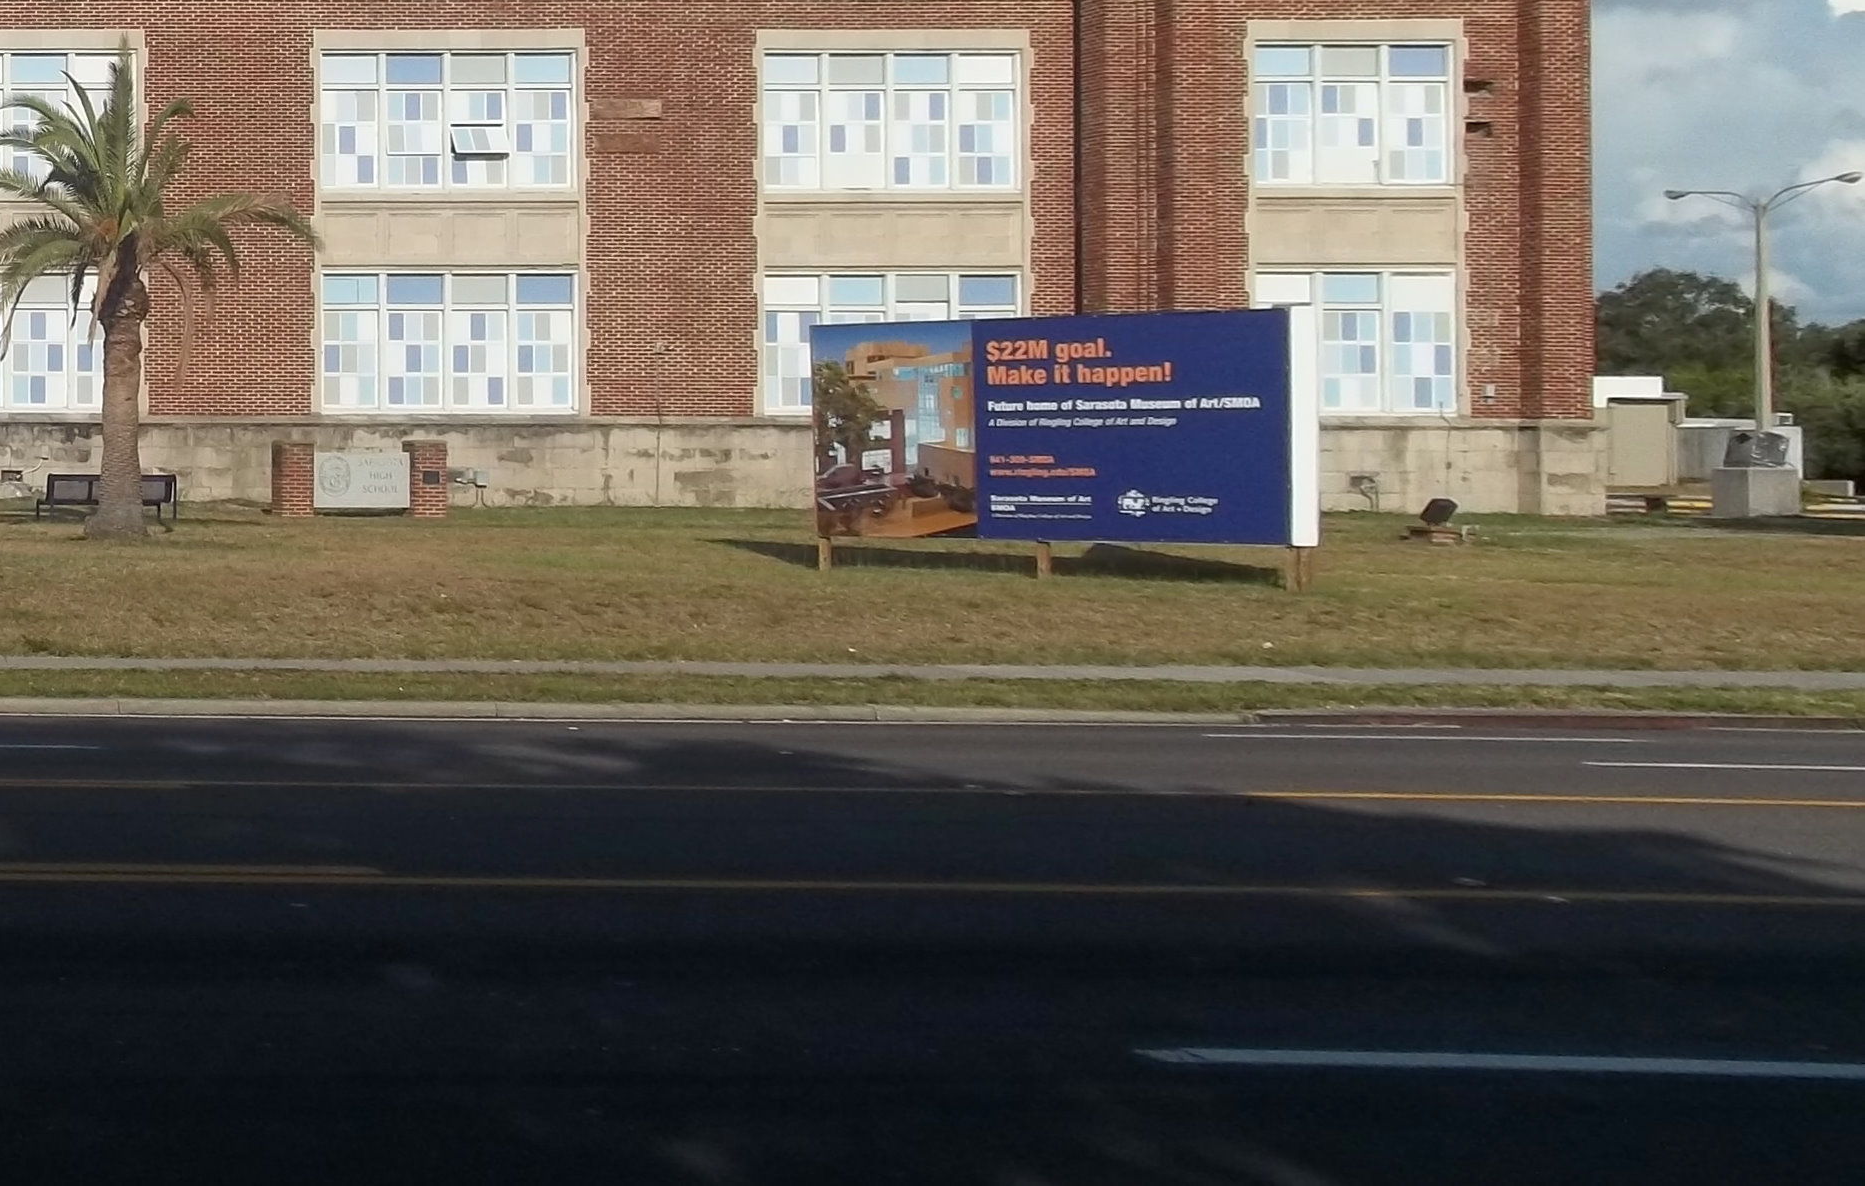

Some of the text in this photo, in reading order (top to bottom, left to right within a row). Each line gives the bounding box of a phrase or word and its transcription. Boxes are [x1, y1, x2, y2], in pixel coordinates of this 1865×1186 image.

[986, 338, 1111, 363] $22M goal.
[987, 362, 1171, 387] Make it happen!
[988, 397, 1261, 411] Future home of Sarasota Museum of Art/SMOA
[989, 416, 1177, 428] A Division of Ringling College of Art and Design
[1187, 496, 1218, 507] College
[1183, 505, 1212, 515] Design
